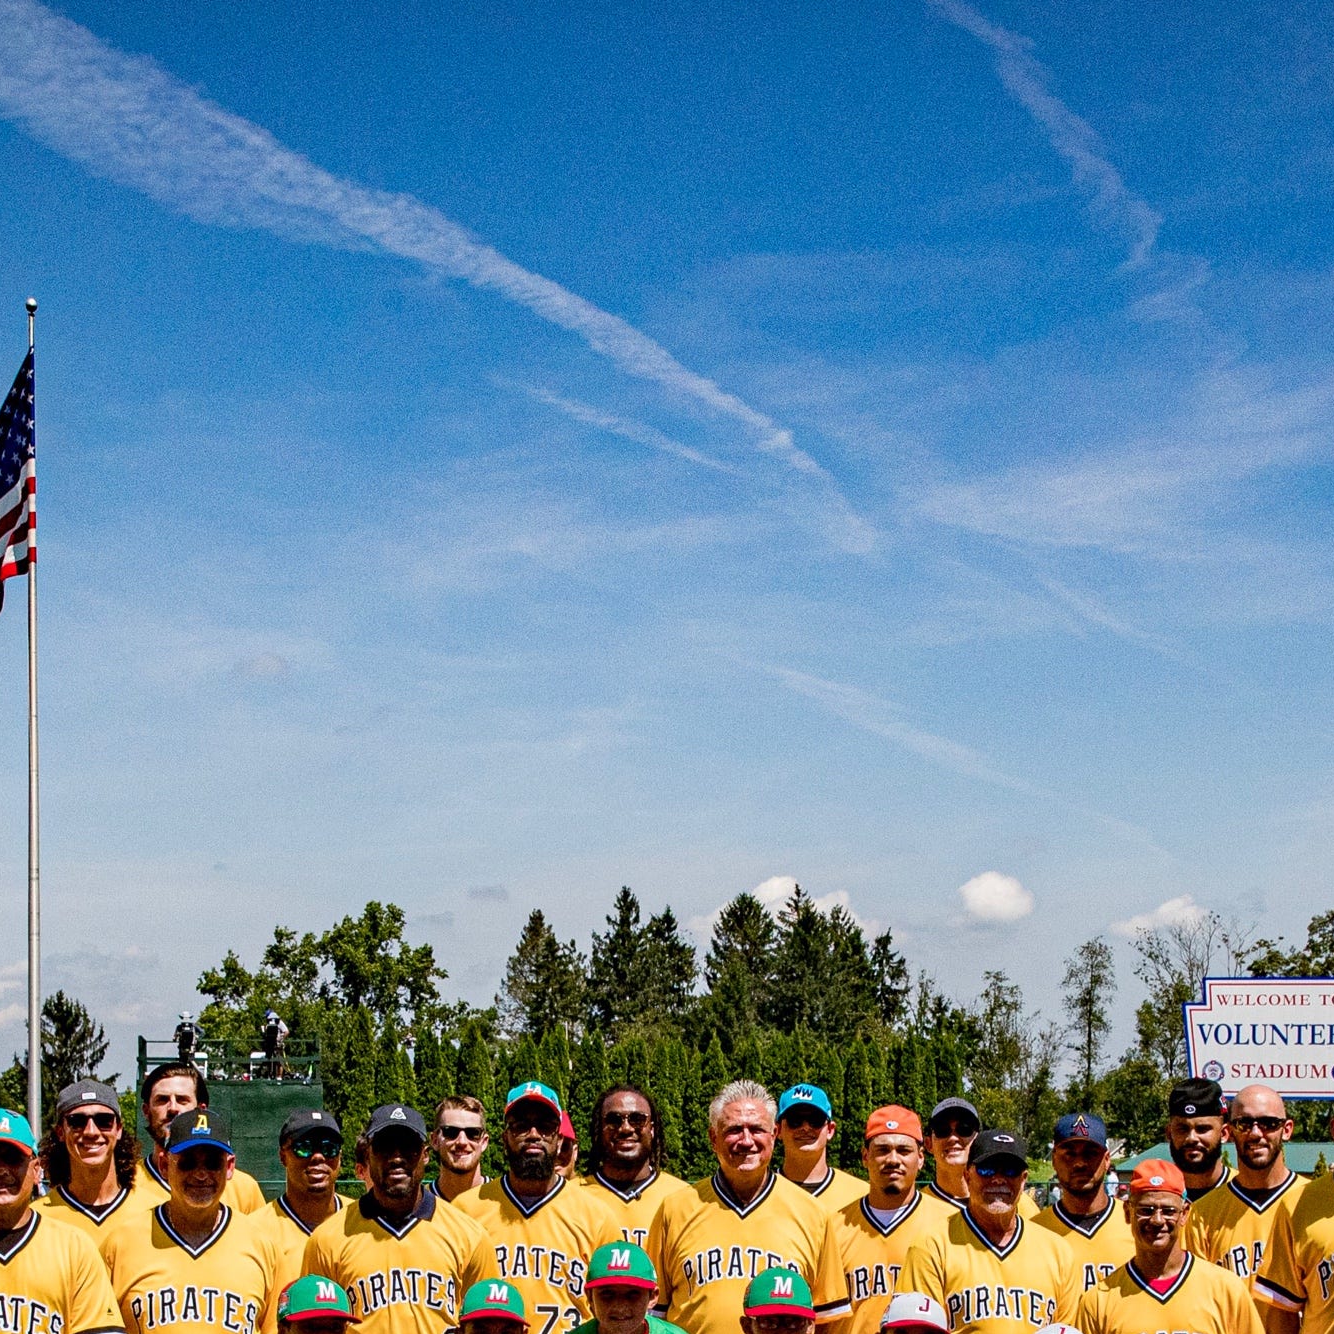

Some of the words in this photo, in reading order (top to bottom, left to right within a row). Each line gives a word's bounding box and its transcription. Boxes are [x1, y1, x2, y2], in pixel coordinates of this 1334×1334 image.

[1216, 993, 1311, 1007] WELCOME
[1231, 1062, 1329, 1079] STADIUM
[195, 1114, 211, 1130] A
[611, 1249, 631, 1268] M
[318, 1282, 337, 1299] M
[345, 1270, 457, 1316] PIRATES
[489, 1285, 509, 1302] M
[774, 1277, 793, 1294] M
[919, 1299, 931, 1313] J
[947, 1286, 1056, 1331] PIRATES
